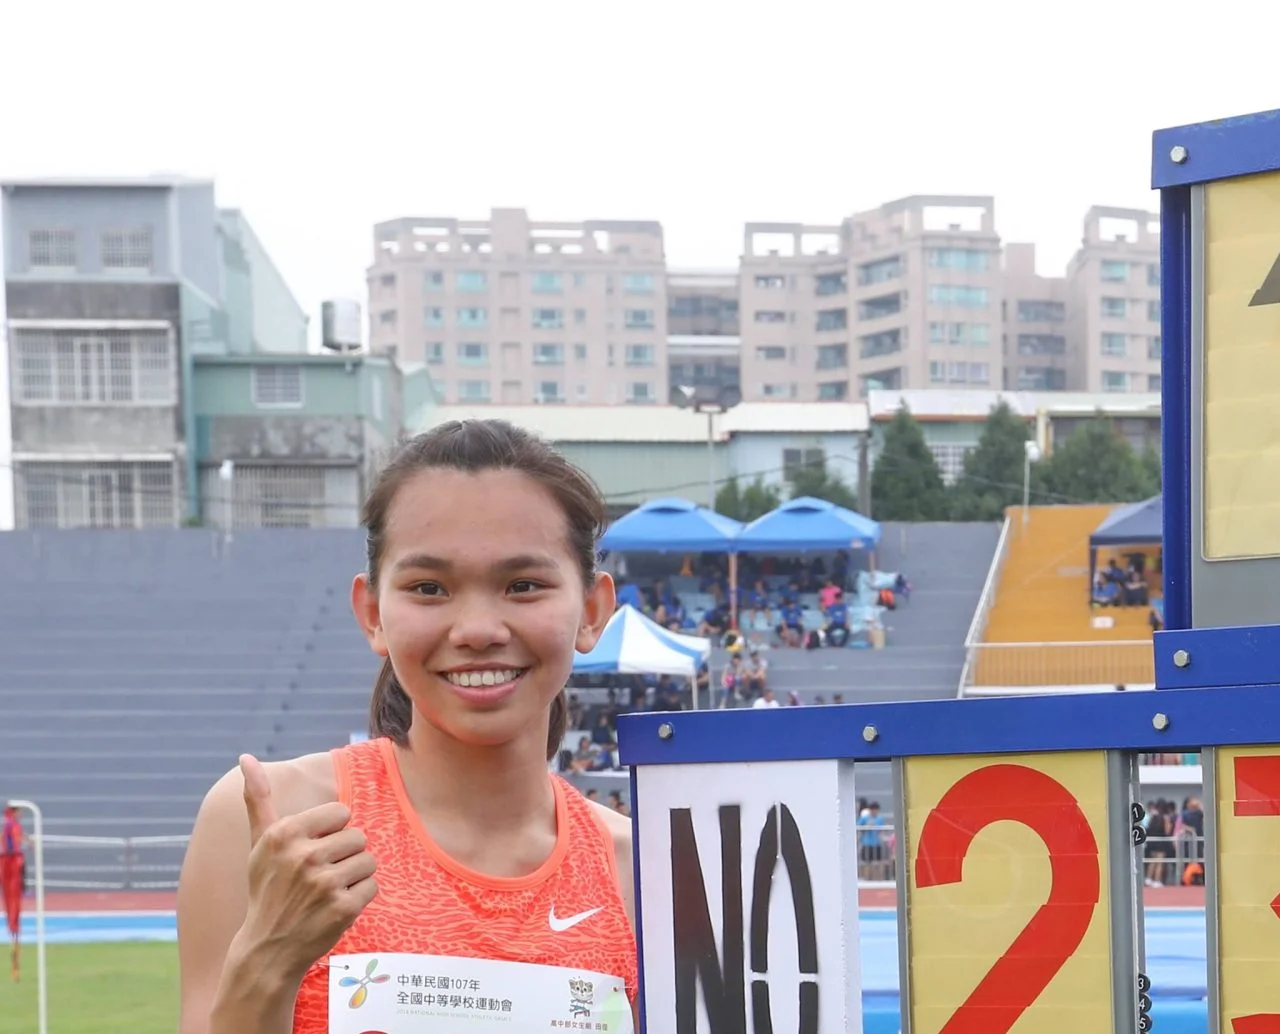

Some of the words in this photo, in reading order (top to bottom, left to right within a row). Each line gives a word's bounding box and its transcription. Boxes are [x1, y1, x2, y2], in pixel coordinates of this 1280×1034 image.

[1133, 808, 1138, 818] 1
[1134, 830, 1140, 841] 2
[397, 974, 481, 991] 中華民國107年
[1139, 978, 1144, 988] 3
[396, 991, 513, 1012] 全國中等學校運動會
[1139, 1000, 1145, 1009] 4
[1140, 1019, 1146, 1029] 5
